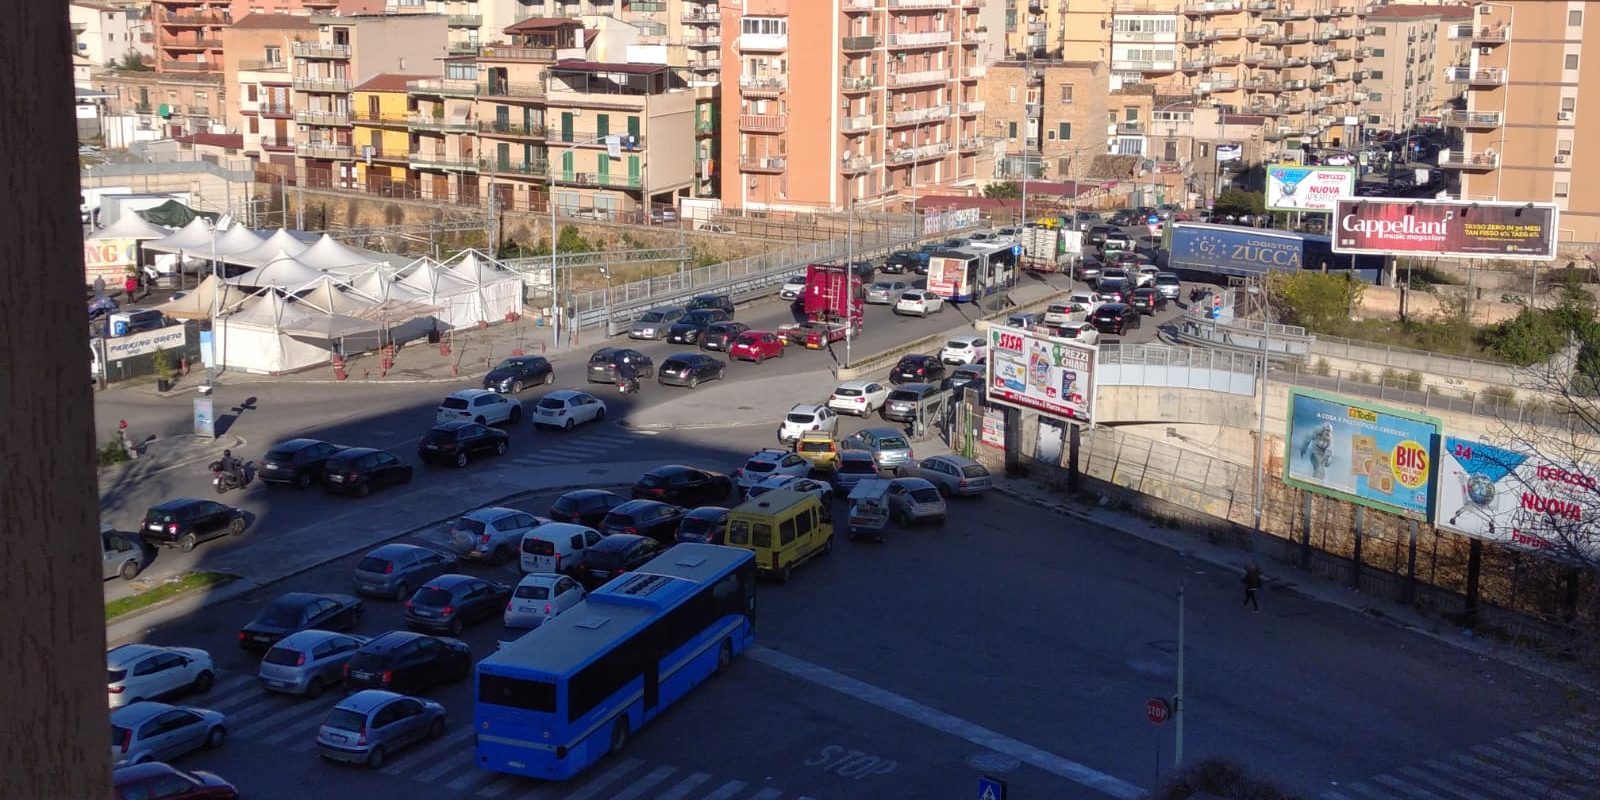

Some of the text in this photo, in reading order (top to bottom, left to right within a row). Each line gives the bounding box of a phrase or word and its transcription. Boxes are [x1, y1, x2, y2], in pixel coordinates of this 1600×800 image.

[1310, 186, 1340, 194] NUOVA
[1342, 213, 1447, 238] Cappellani
[1487, 223, 1506, 231] ZERO
[1247, 239, 1300, 252] LOGISTICA
[1406, 233, 1446, 242] megastore
[1231, 244, 1299, 266] ZUCCA
[111, 339, 151, 353] PARKING
[153, 332, 182, 344] ORETO
[999, 332, 1022, 351] SISA
[1060, 346, 1089, 362] PREZZI
[1356, 409, 1377, 422] Todis
[1396, 445, 1426, 471] BIIS
[1455, 443, 1472, 460] 24
[1521, 491, 1582, 522] NUOVA
[1147, 705, 1166, 718] STOP
[803, 745, 897, 780] STOP
